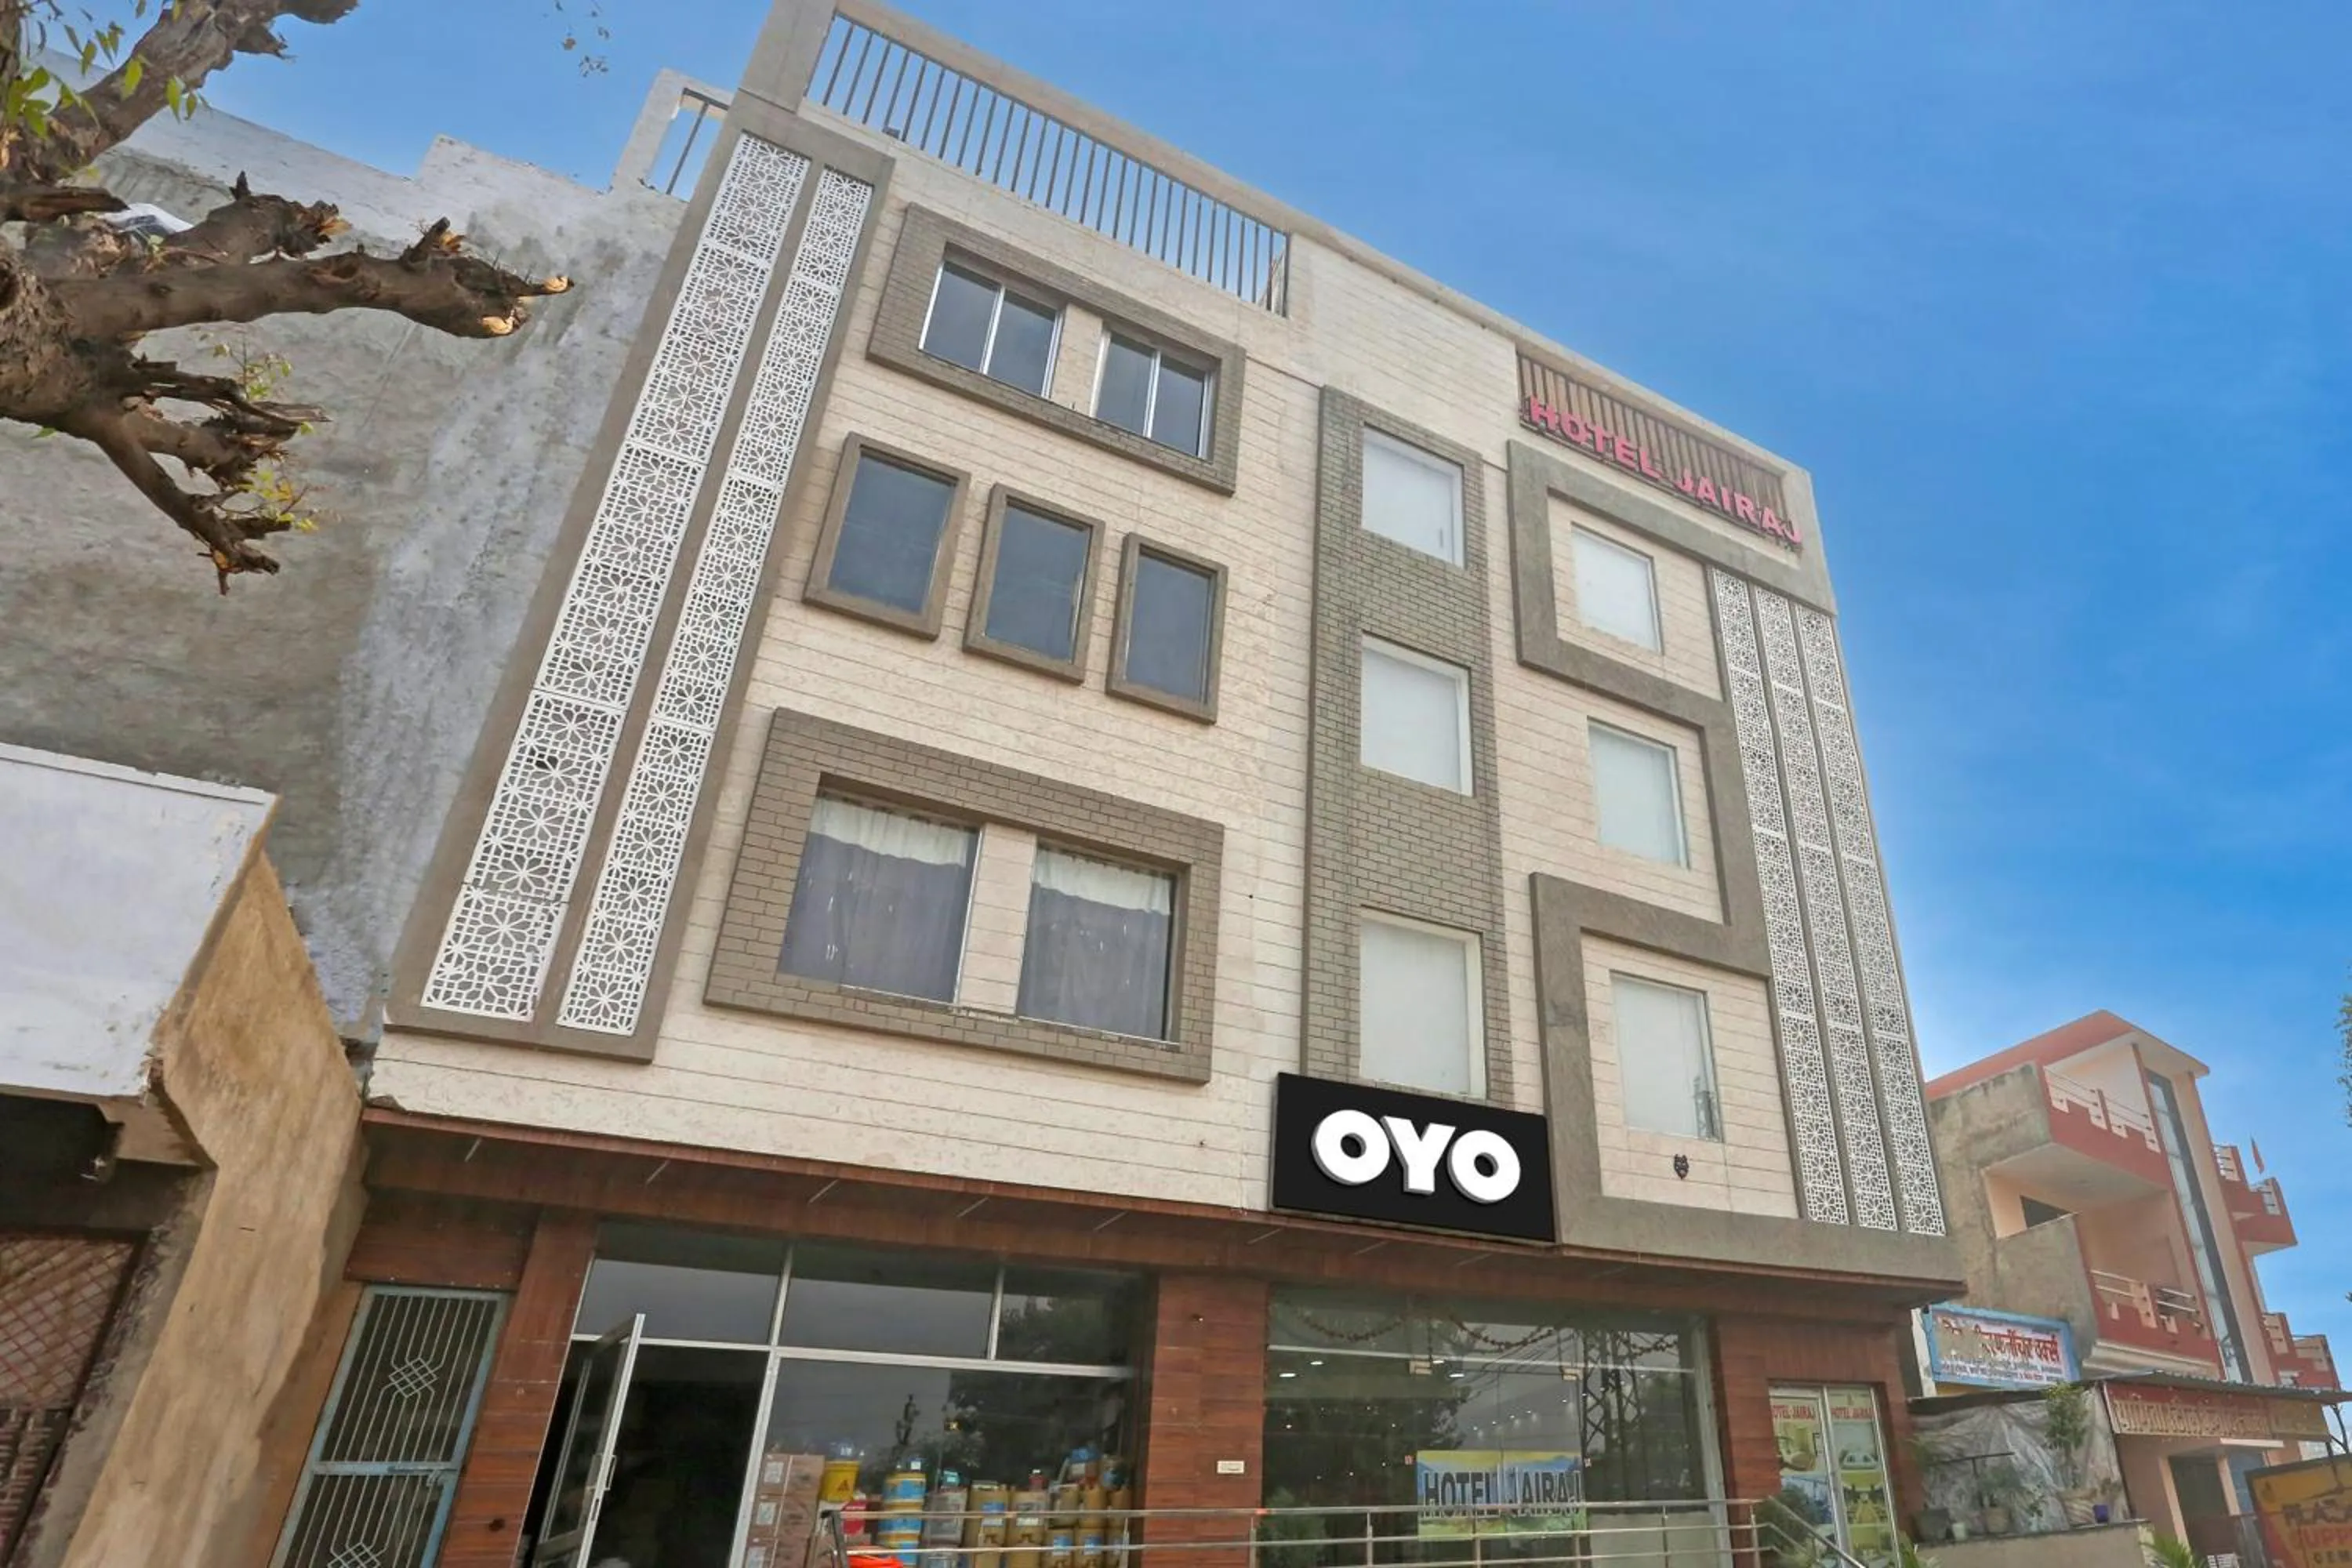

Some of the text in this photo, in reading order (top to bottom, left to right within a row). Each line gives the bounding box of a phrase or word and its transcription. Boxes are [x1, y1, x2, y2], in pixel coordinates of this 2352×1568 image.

[1530, 395, 1802, 545] HOTEL JAIRAJ
[1311, 1109, 1521, 1204] OYO
[1422, 1471, 1501, 1518] HOTEL
